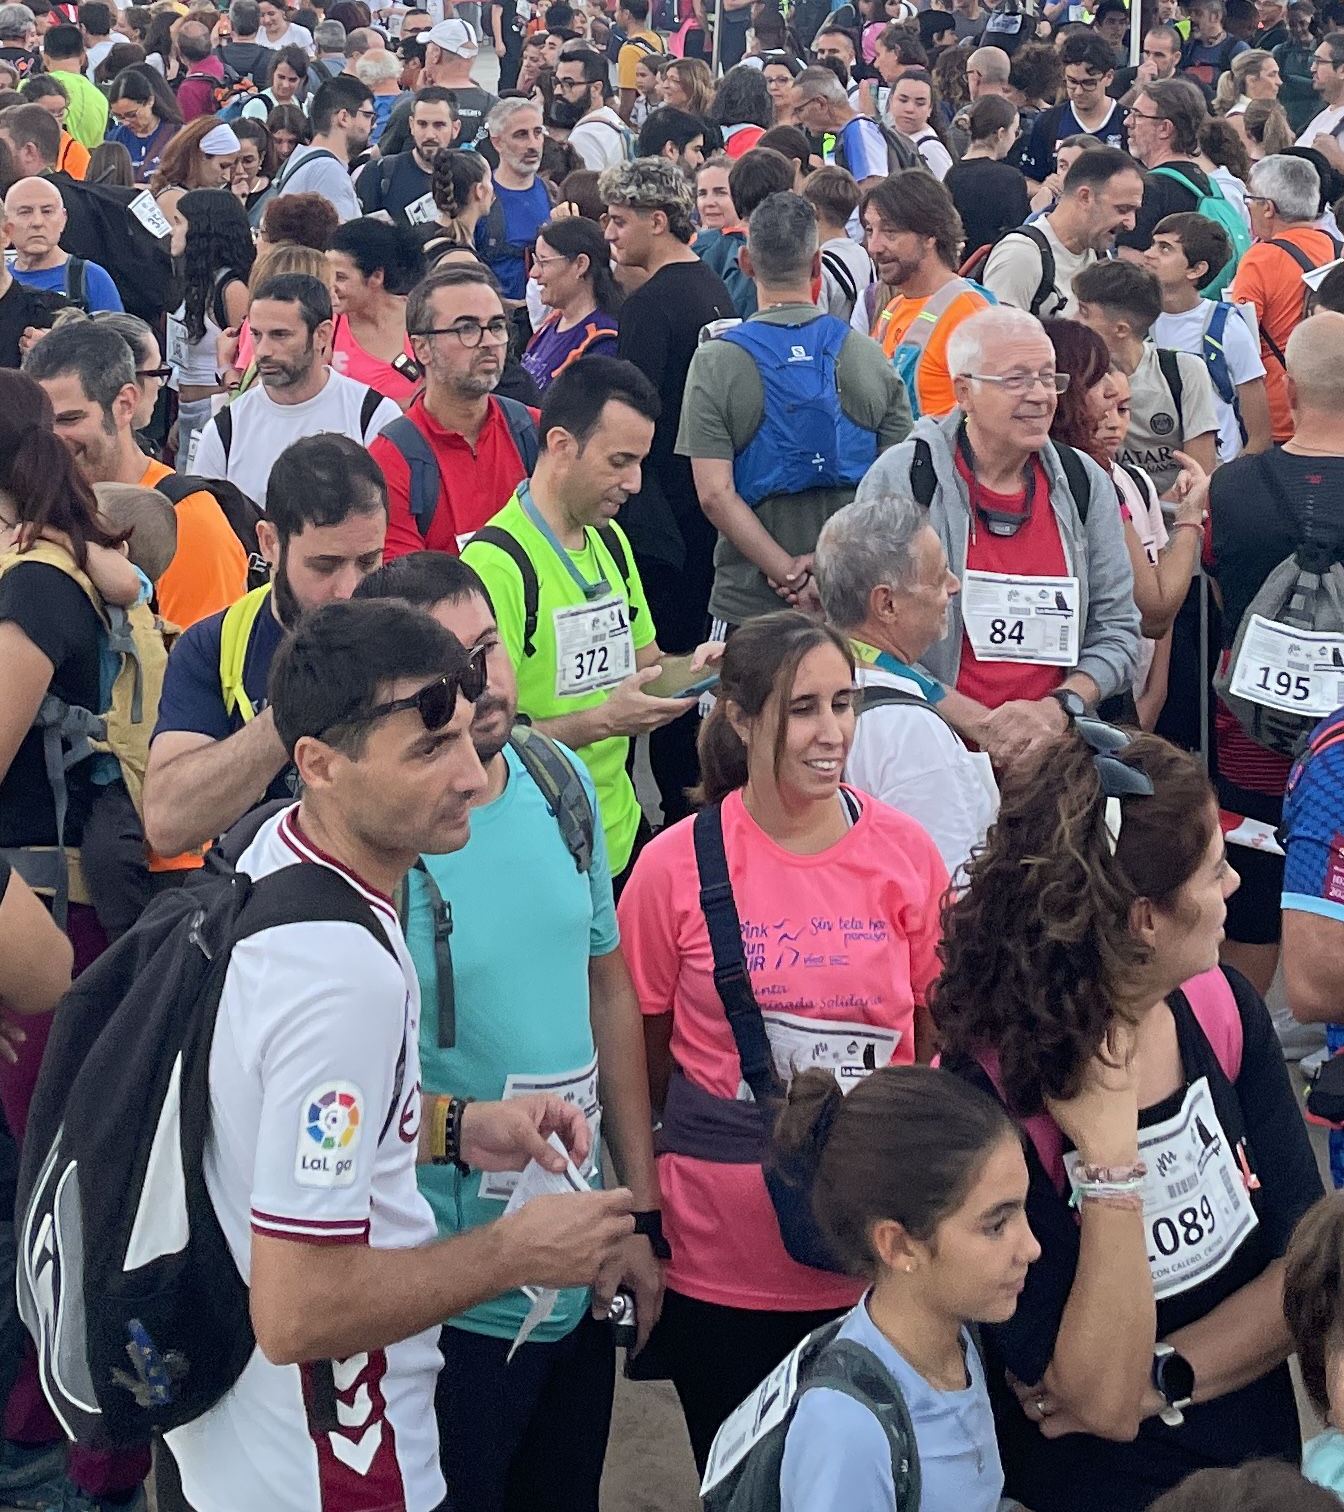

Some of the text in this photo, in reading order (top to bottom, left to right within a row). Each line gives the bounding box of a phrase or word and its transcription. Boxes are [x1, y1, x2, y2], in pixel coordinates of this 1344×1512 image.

[1114, 445, 1172, 466] ATAR
[989, 618, 1025, 645] 84
[574, 646, 609, 680] 372
[1256, 666, 1311, 701] 195
[302, 1155, 353, 1176] LaLga
[1148, 1194, 1215, 1260] 089
